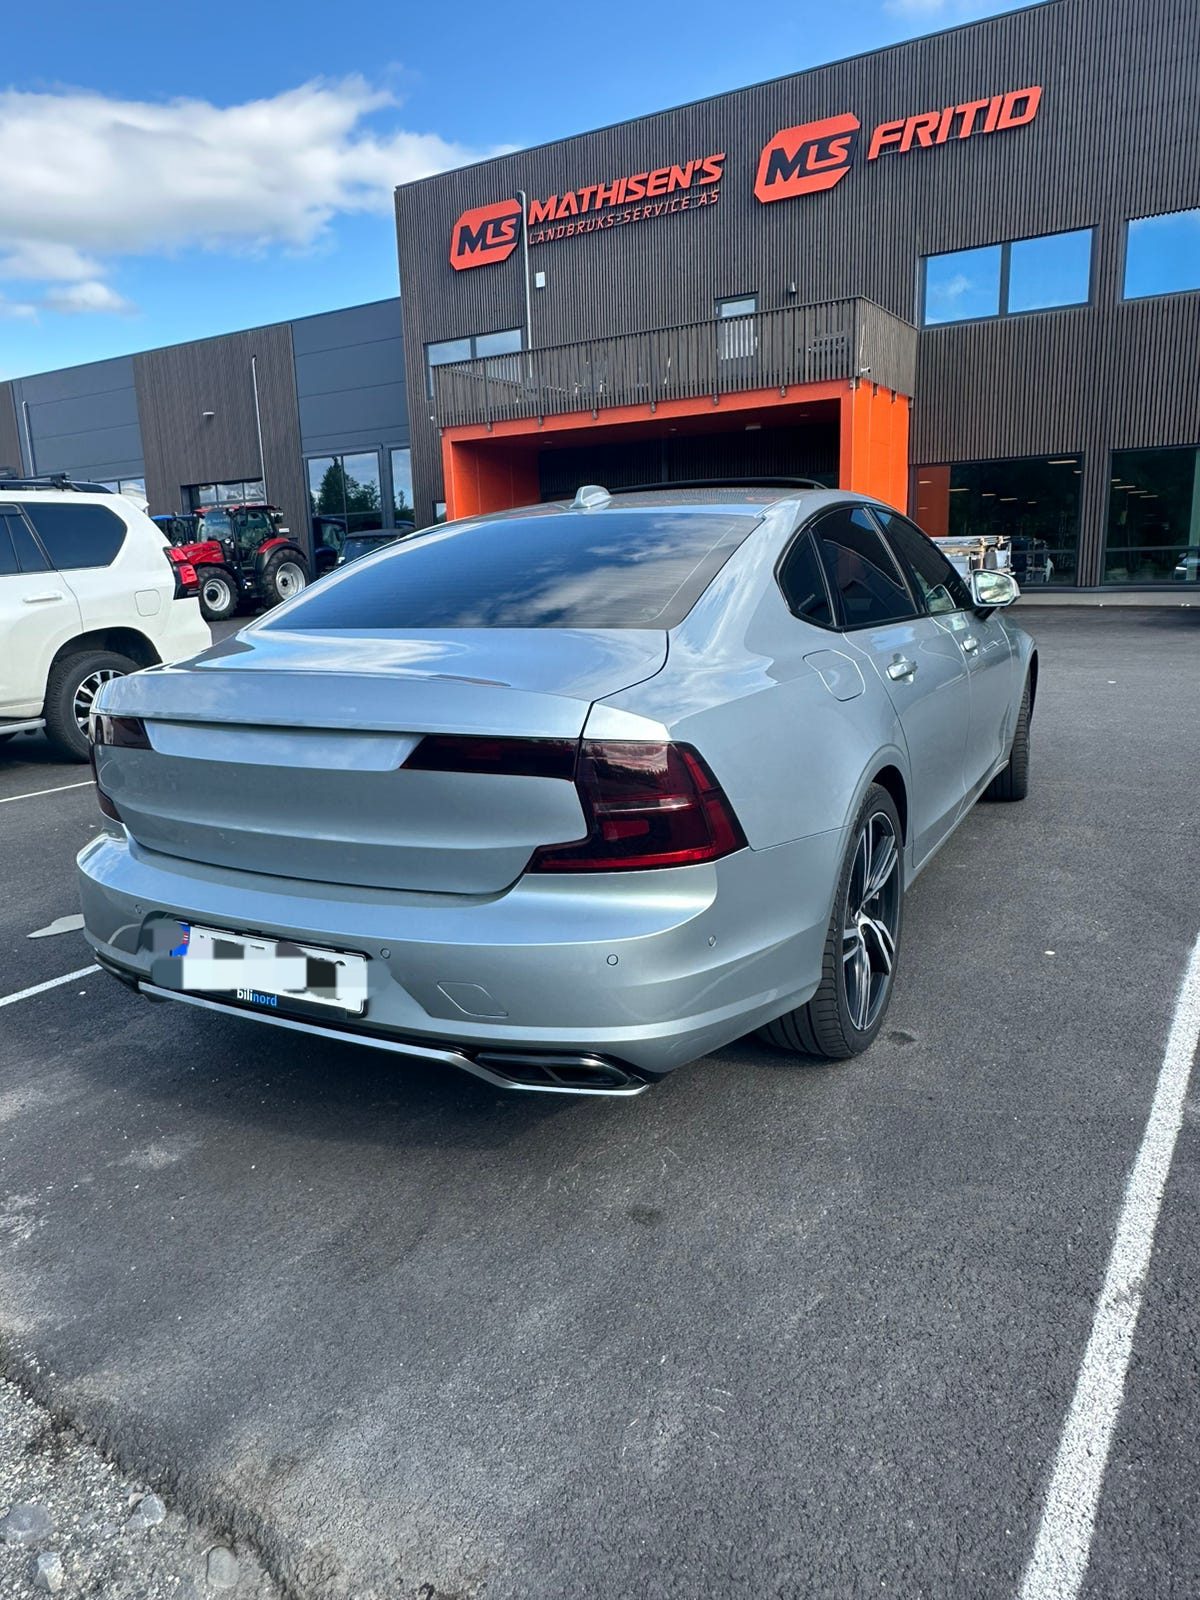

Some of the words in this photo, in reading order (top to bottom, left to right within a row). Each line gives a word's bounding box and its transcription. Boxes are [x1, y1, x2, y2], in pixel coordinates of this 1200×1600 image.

[763, 135, 853, 187] MLS
[867, 85, 1043, 161] FRITID
[527, 152, 727, 226] MATHISEN'S
[699, 188, 721, 206] AS
[456, 216, 518, 257] MLS
